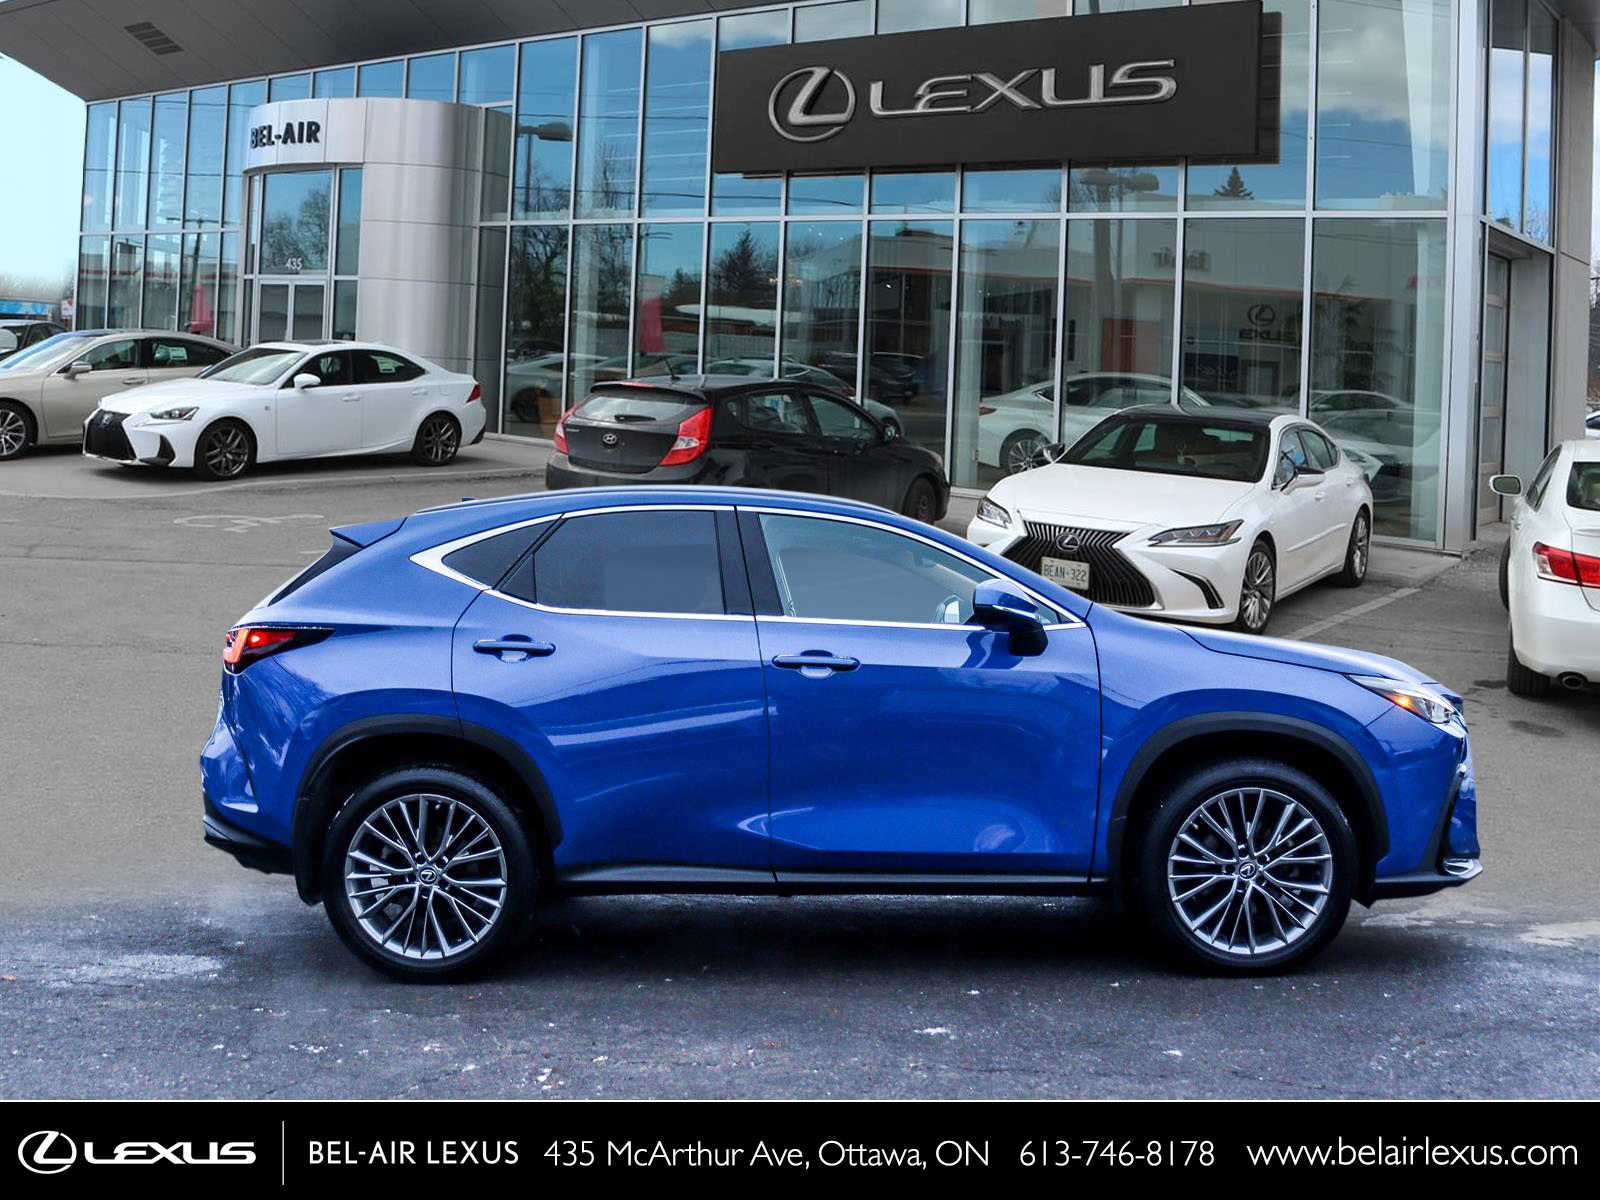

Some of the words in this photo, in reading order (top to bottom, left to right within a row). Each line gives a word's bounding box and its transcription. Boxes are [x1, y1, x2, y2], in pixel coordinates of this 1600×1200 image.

[869, 58, 1178, 118] LEXUS
[250, 120, 321, 149] BEL-AIR
[285, 257, 303, 270] 435
